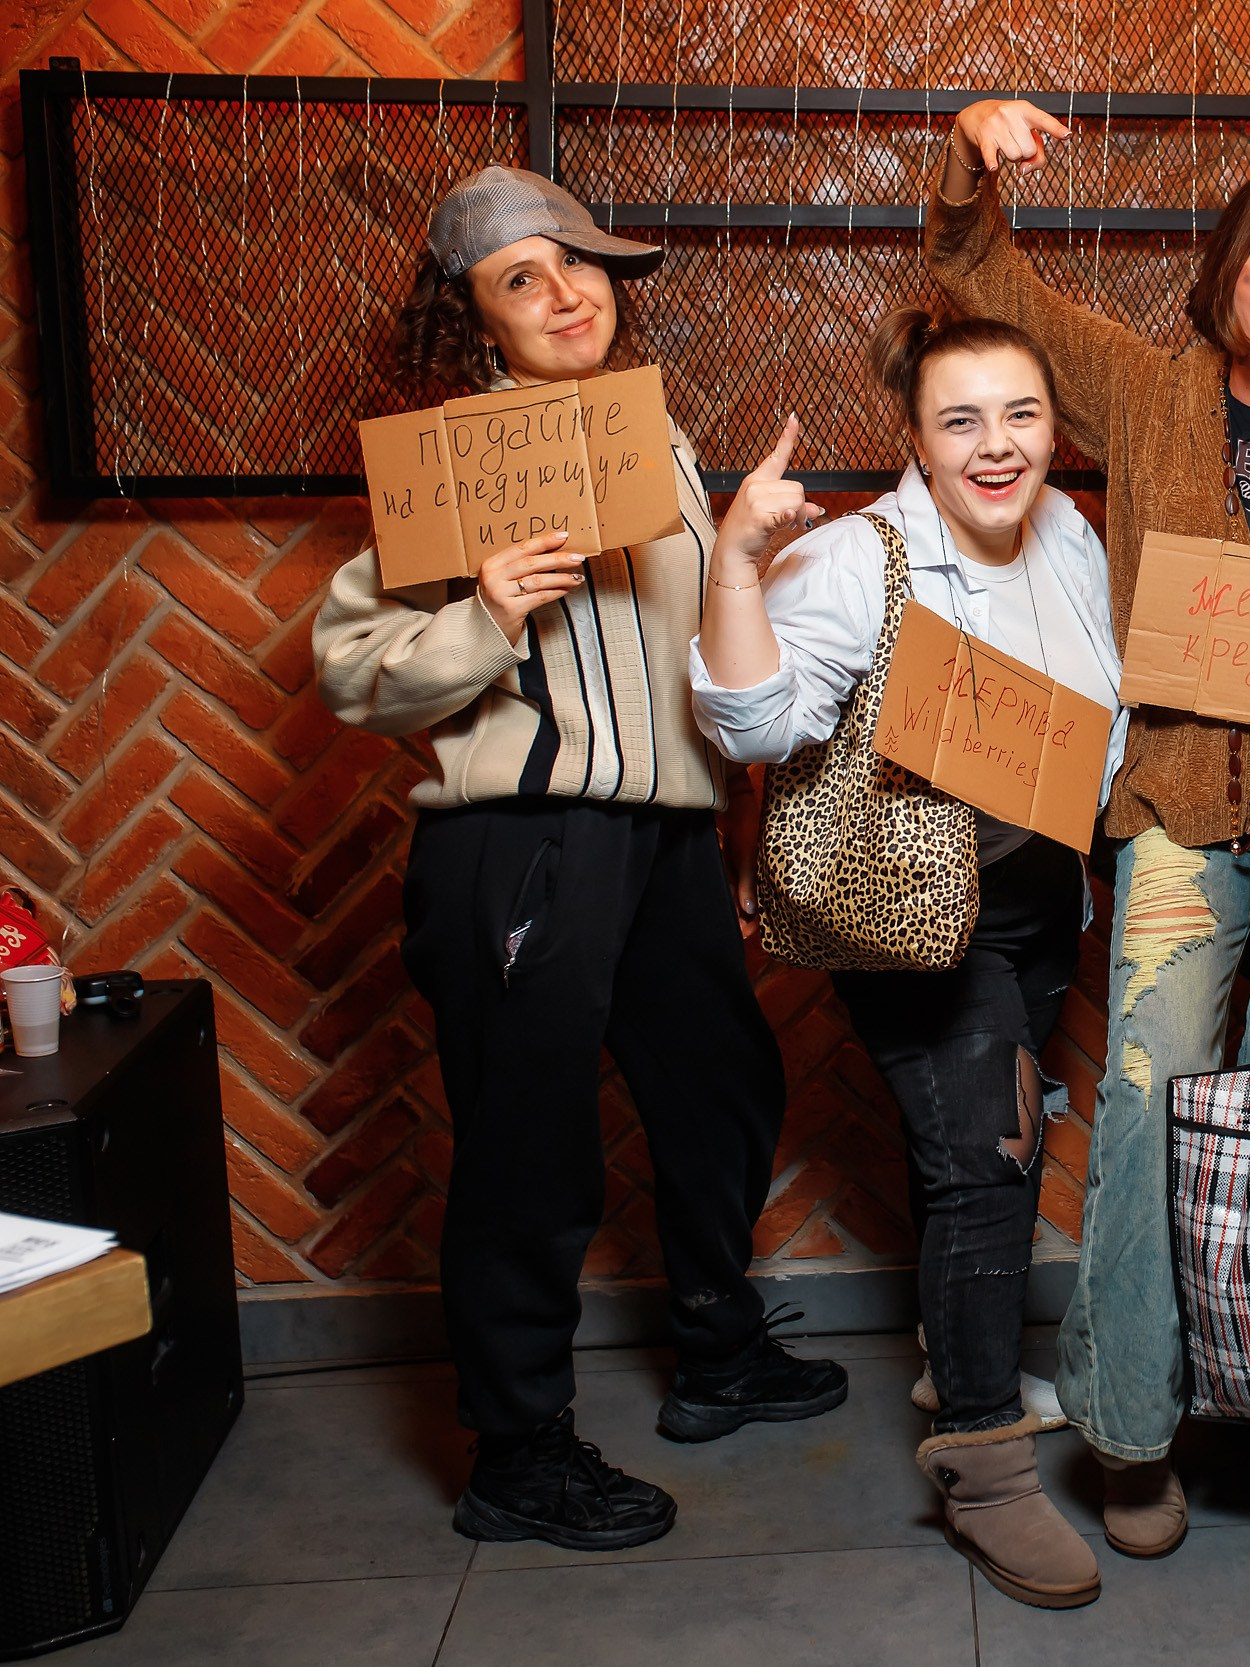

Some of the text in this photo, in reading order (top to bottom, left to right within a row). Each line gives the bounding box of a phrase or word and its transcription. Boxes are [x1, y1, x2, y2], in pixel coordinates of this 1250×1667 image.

[418, 400, 629, 475] Подайте
[383, 451, 640, 519] на следующую
